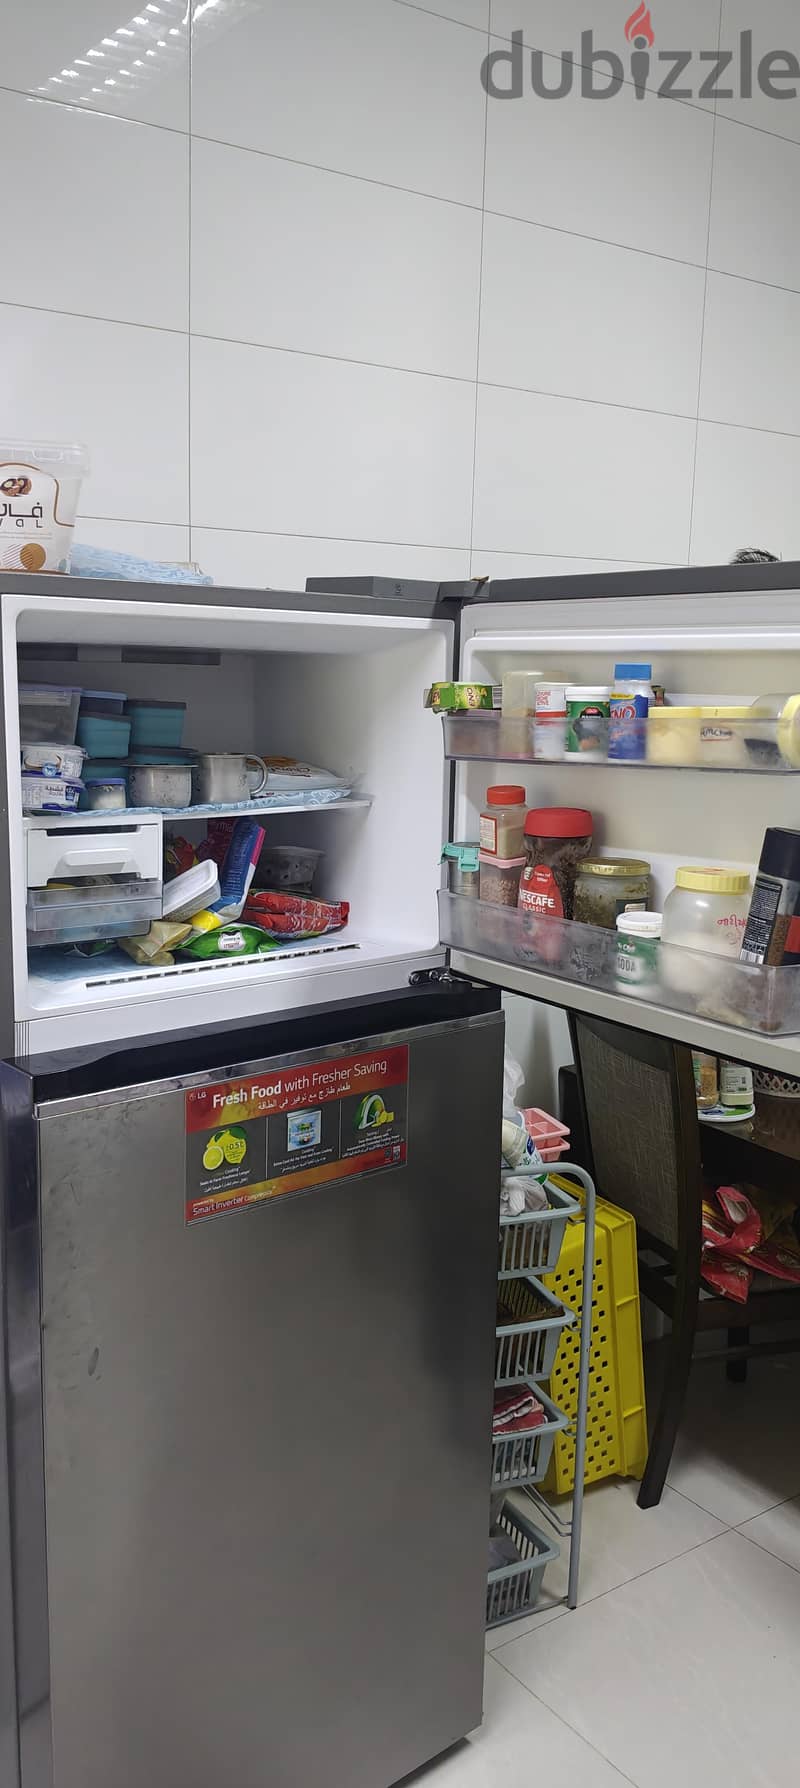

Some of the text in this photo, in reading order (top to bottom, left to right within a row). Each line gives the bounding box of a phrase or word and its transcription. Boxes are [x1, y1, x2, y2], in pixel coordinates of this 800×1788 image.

[522, 902, 547, 914] CLASSIC
[213, 1060, 387, 1109] Fresh Food with Fresher Saving
[192, 1205, 216, 1216] Smart
[215, 1194, 245, 1209] Inverter
